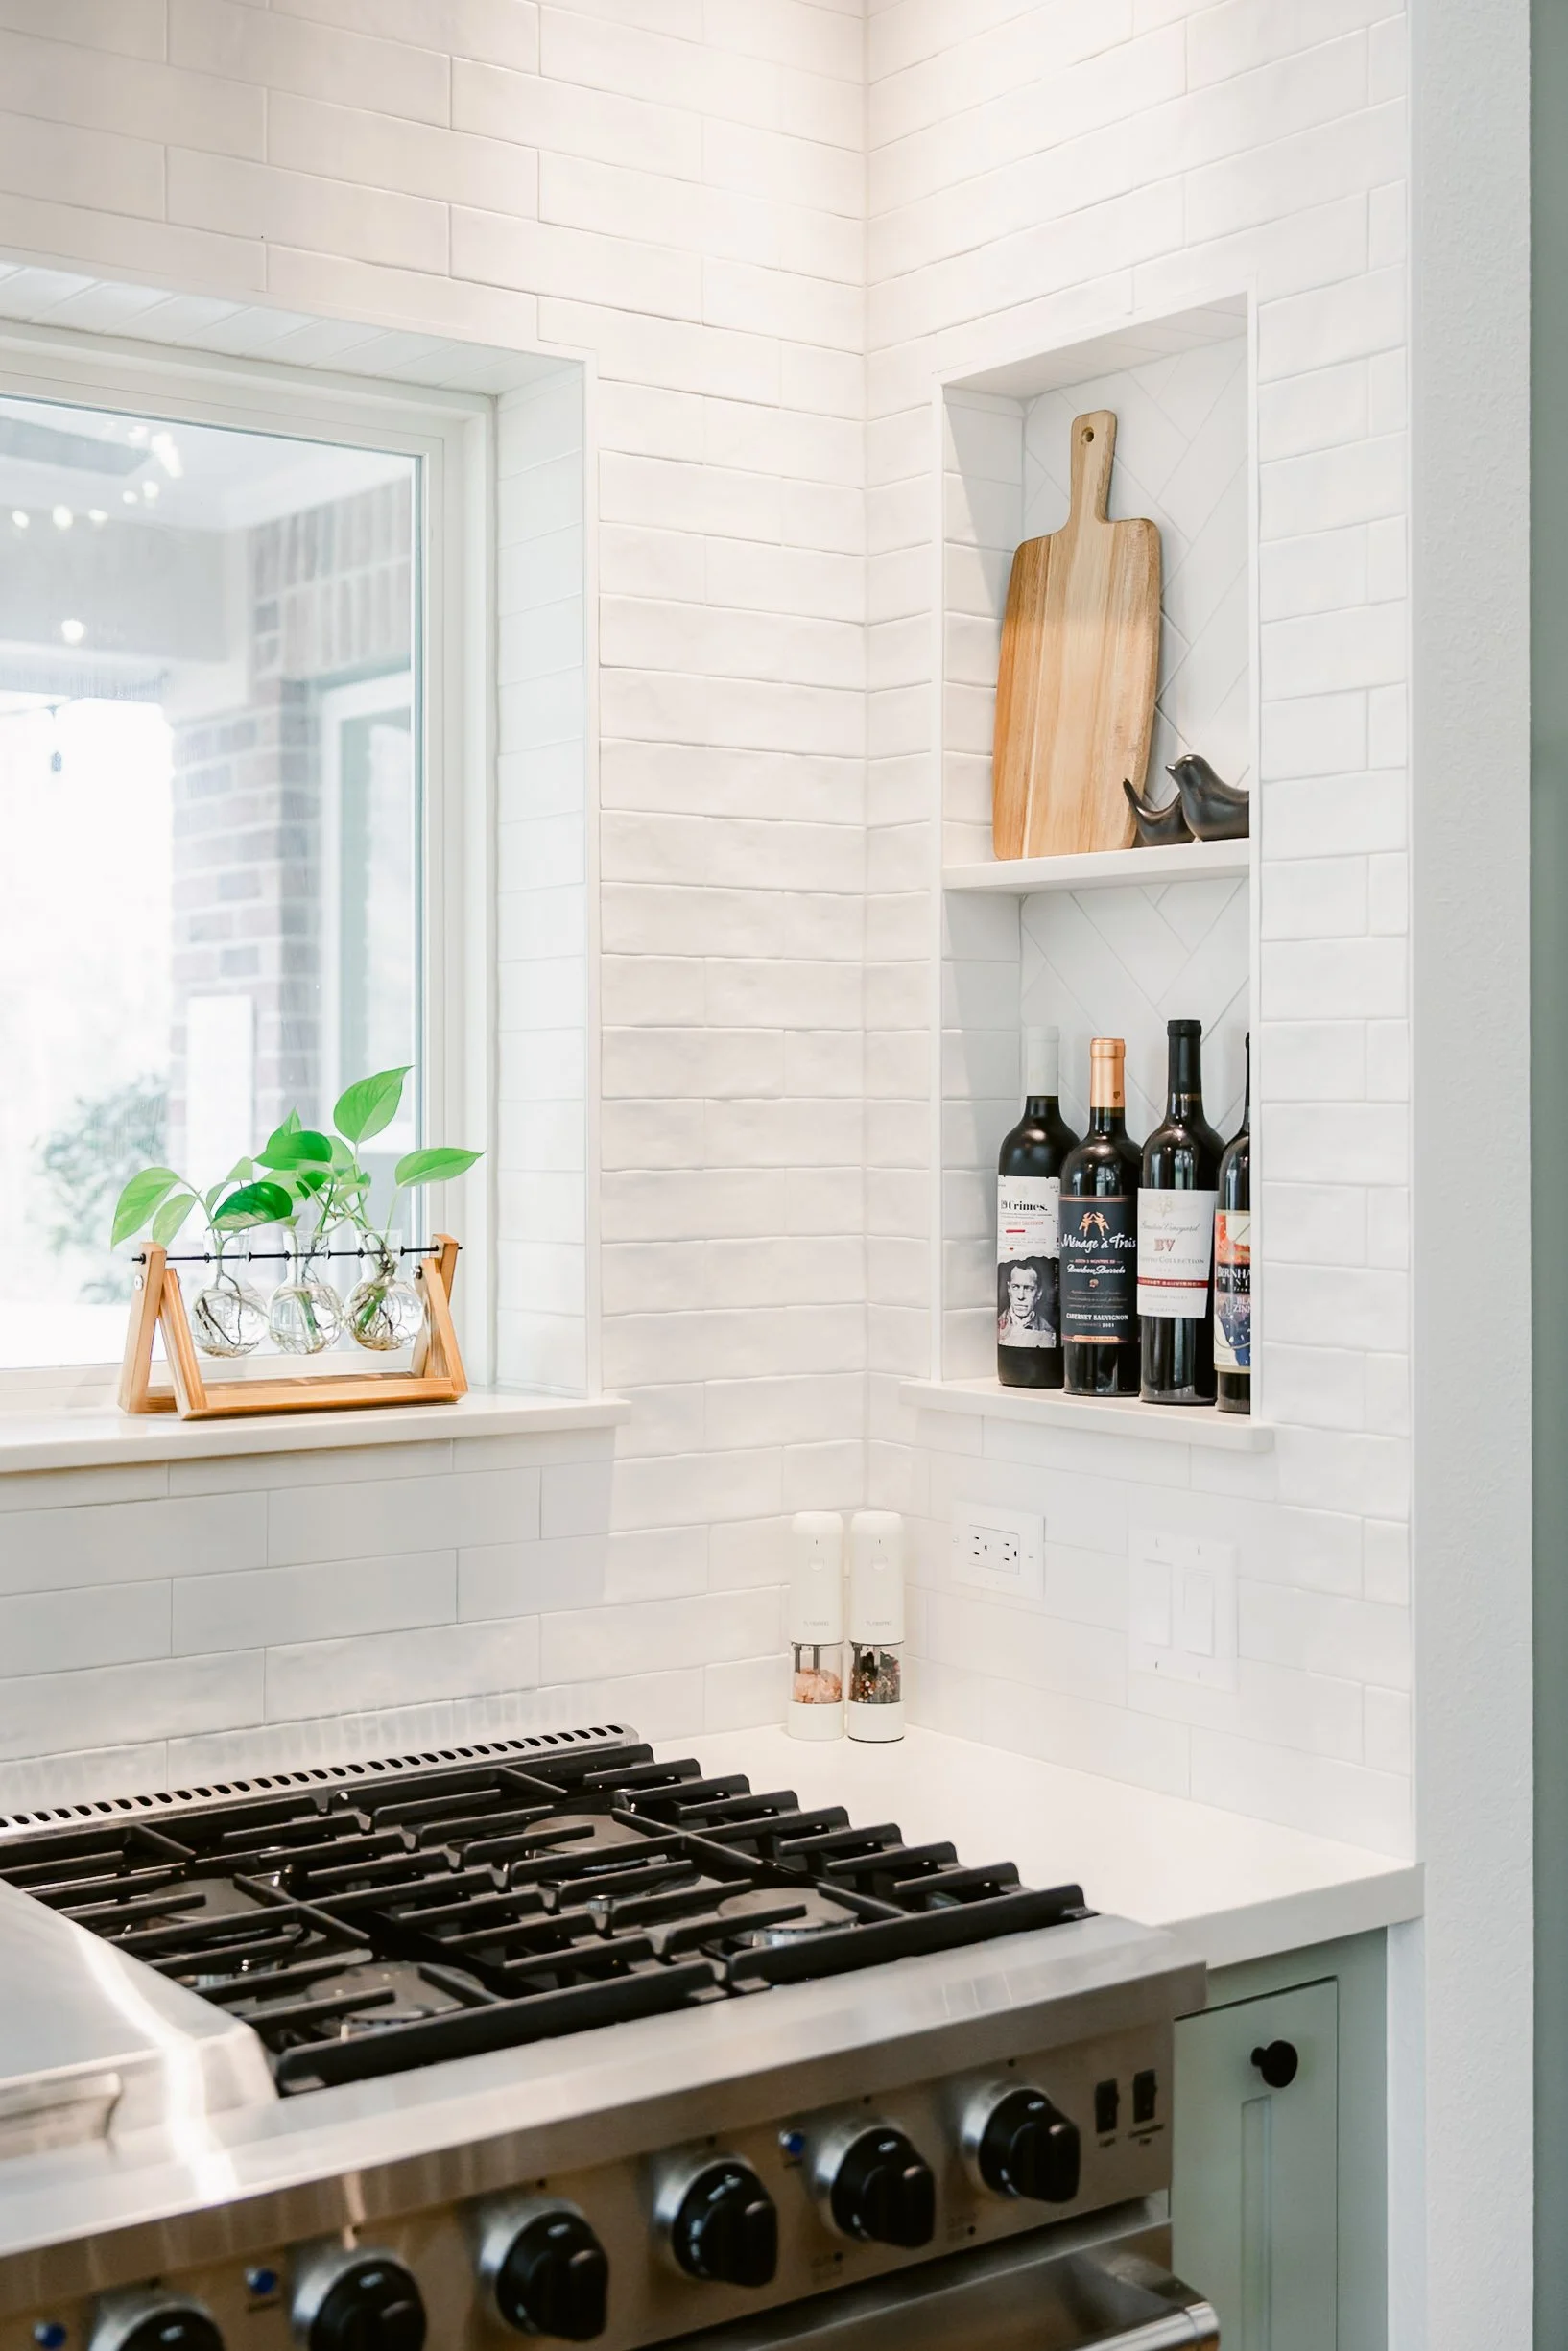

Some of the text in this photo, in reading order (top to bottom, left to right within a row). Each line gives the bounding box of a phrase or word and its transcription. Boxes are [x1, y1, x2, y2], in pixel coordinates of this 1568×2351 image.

[1061, 1233, 1099, 1253] Ménage
[1100, 1237, 1109, 1249] à
[1109, 1232, 1136, 1249] Trois
[1153, 1238, 1176, 1252] BV
[1066, 1313, 1128, 1322] CABERNET SAUVIGNON
